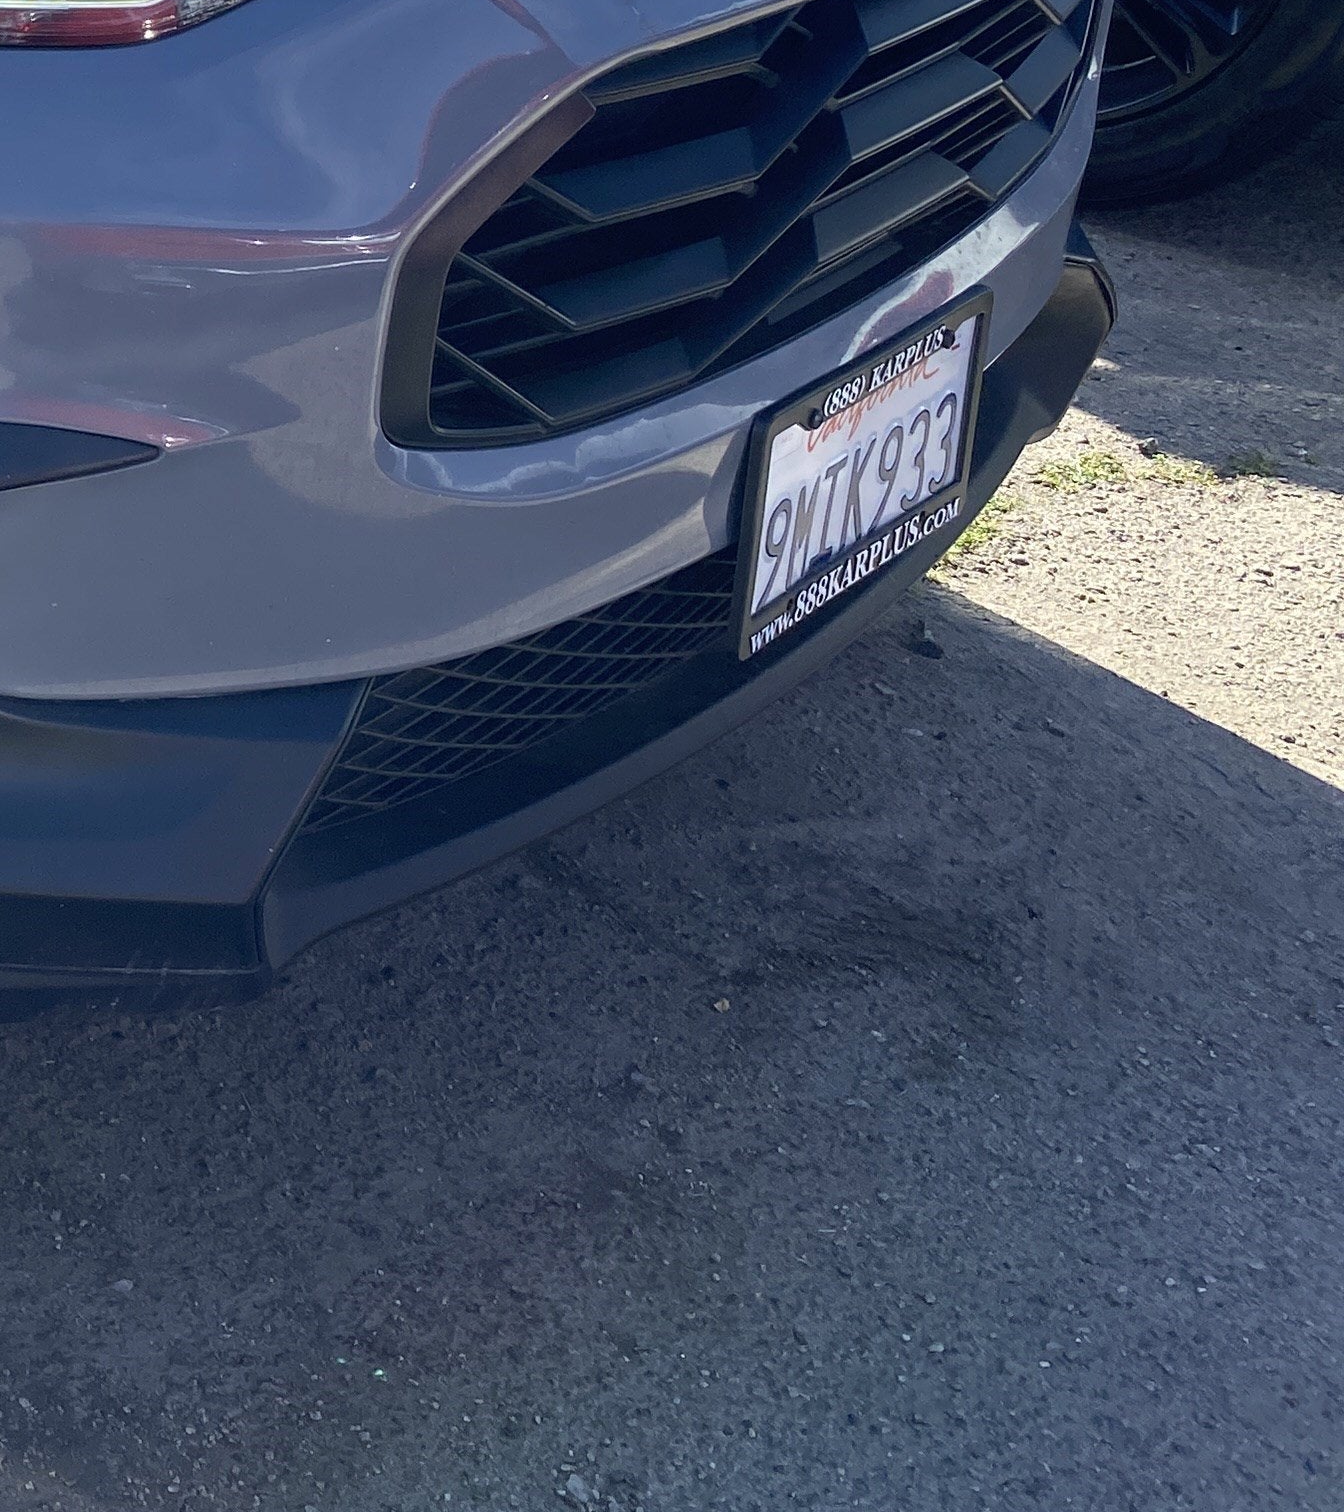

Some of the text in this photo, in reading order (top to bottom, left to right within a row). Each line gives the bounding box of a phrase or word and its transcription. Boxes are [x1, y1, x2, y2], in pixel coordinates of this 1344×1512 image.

[824, 325, 946, 417] (888) KARPLUS
[755, 391, 958, 613] 9MIK933
